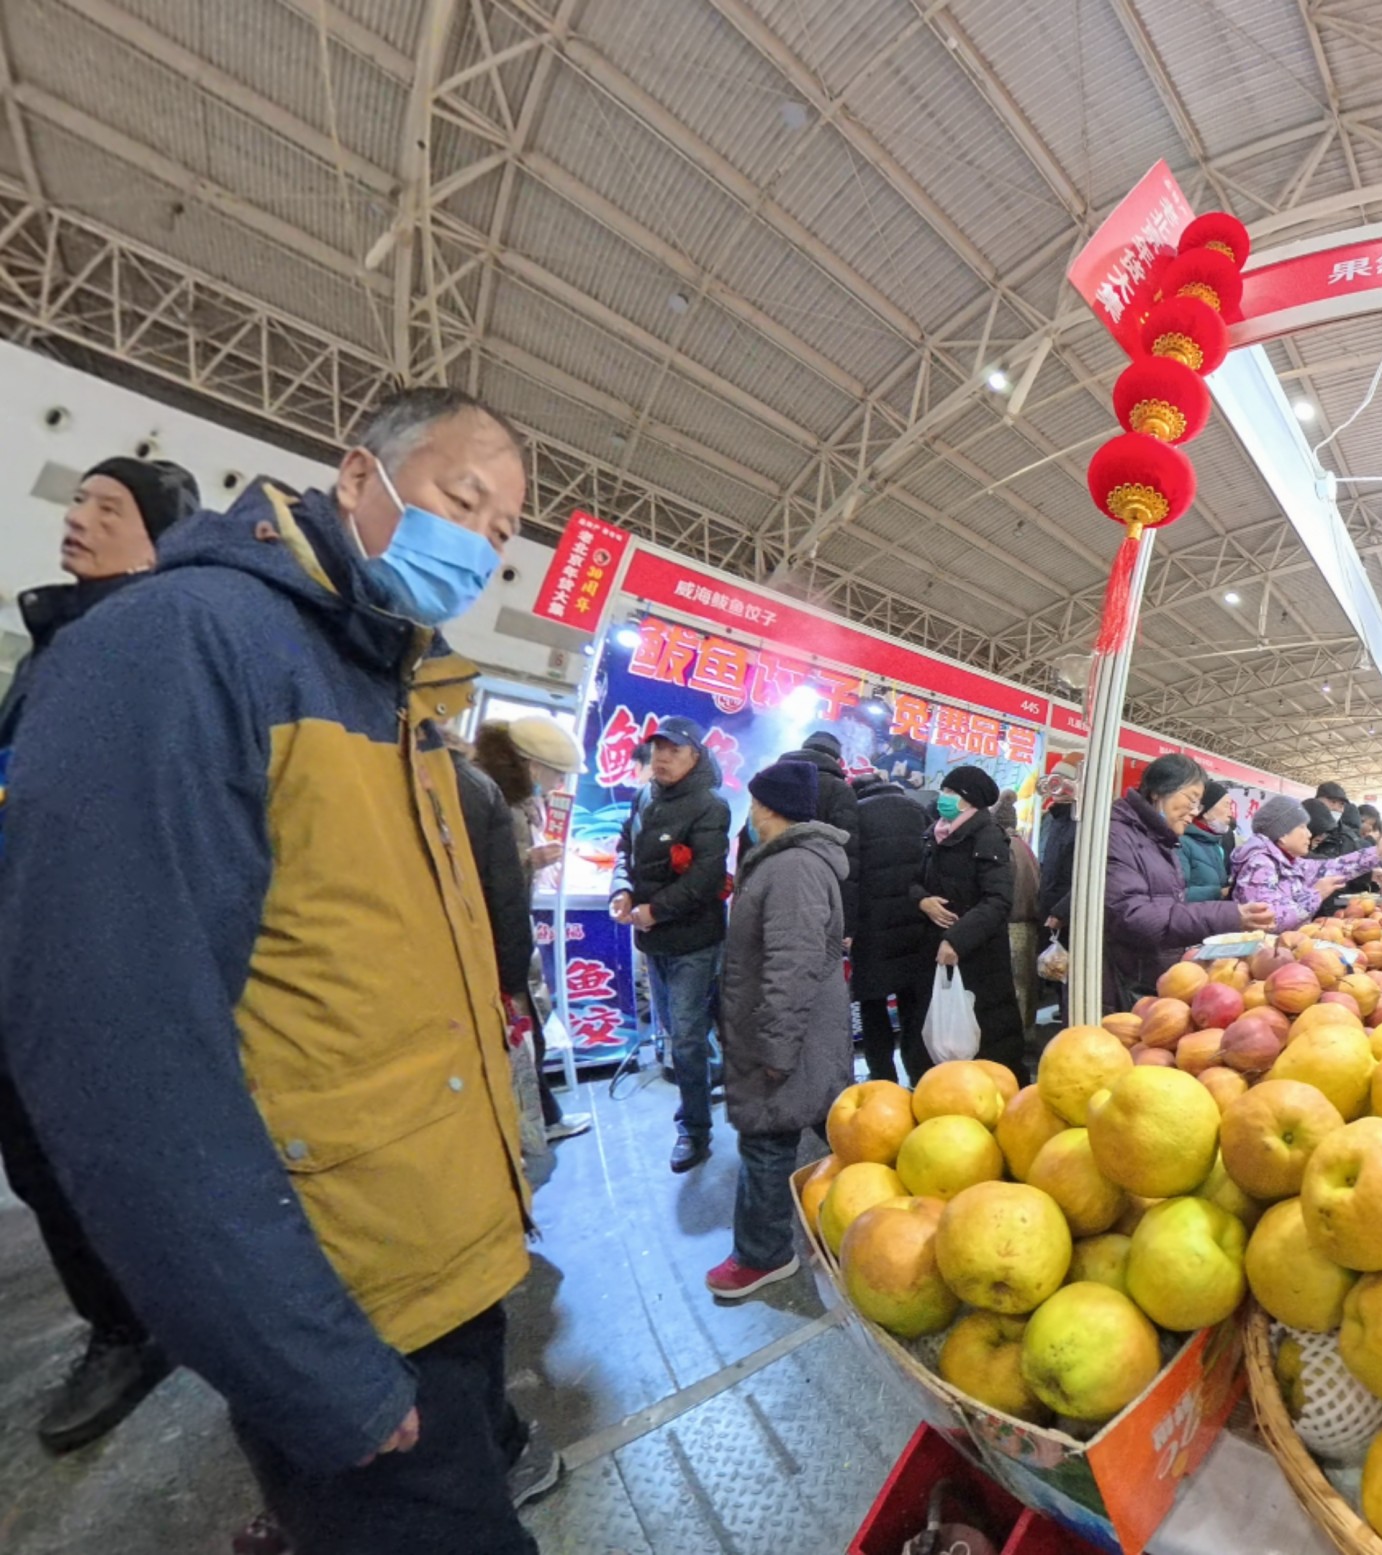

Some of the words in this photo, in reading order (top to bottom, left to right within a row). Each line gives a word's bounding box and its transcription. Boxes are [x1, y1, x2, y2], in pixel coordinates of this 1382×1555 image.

[674, 579, 778, 627] 威海鲅鱼饺子
[1019, 700, 1040, 715] 445
